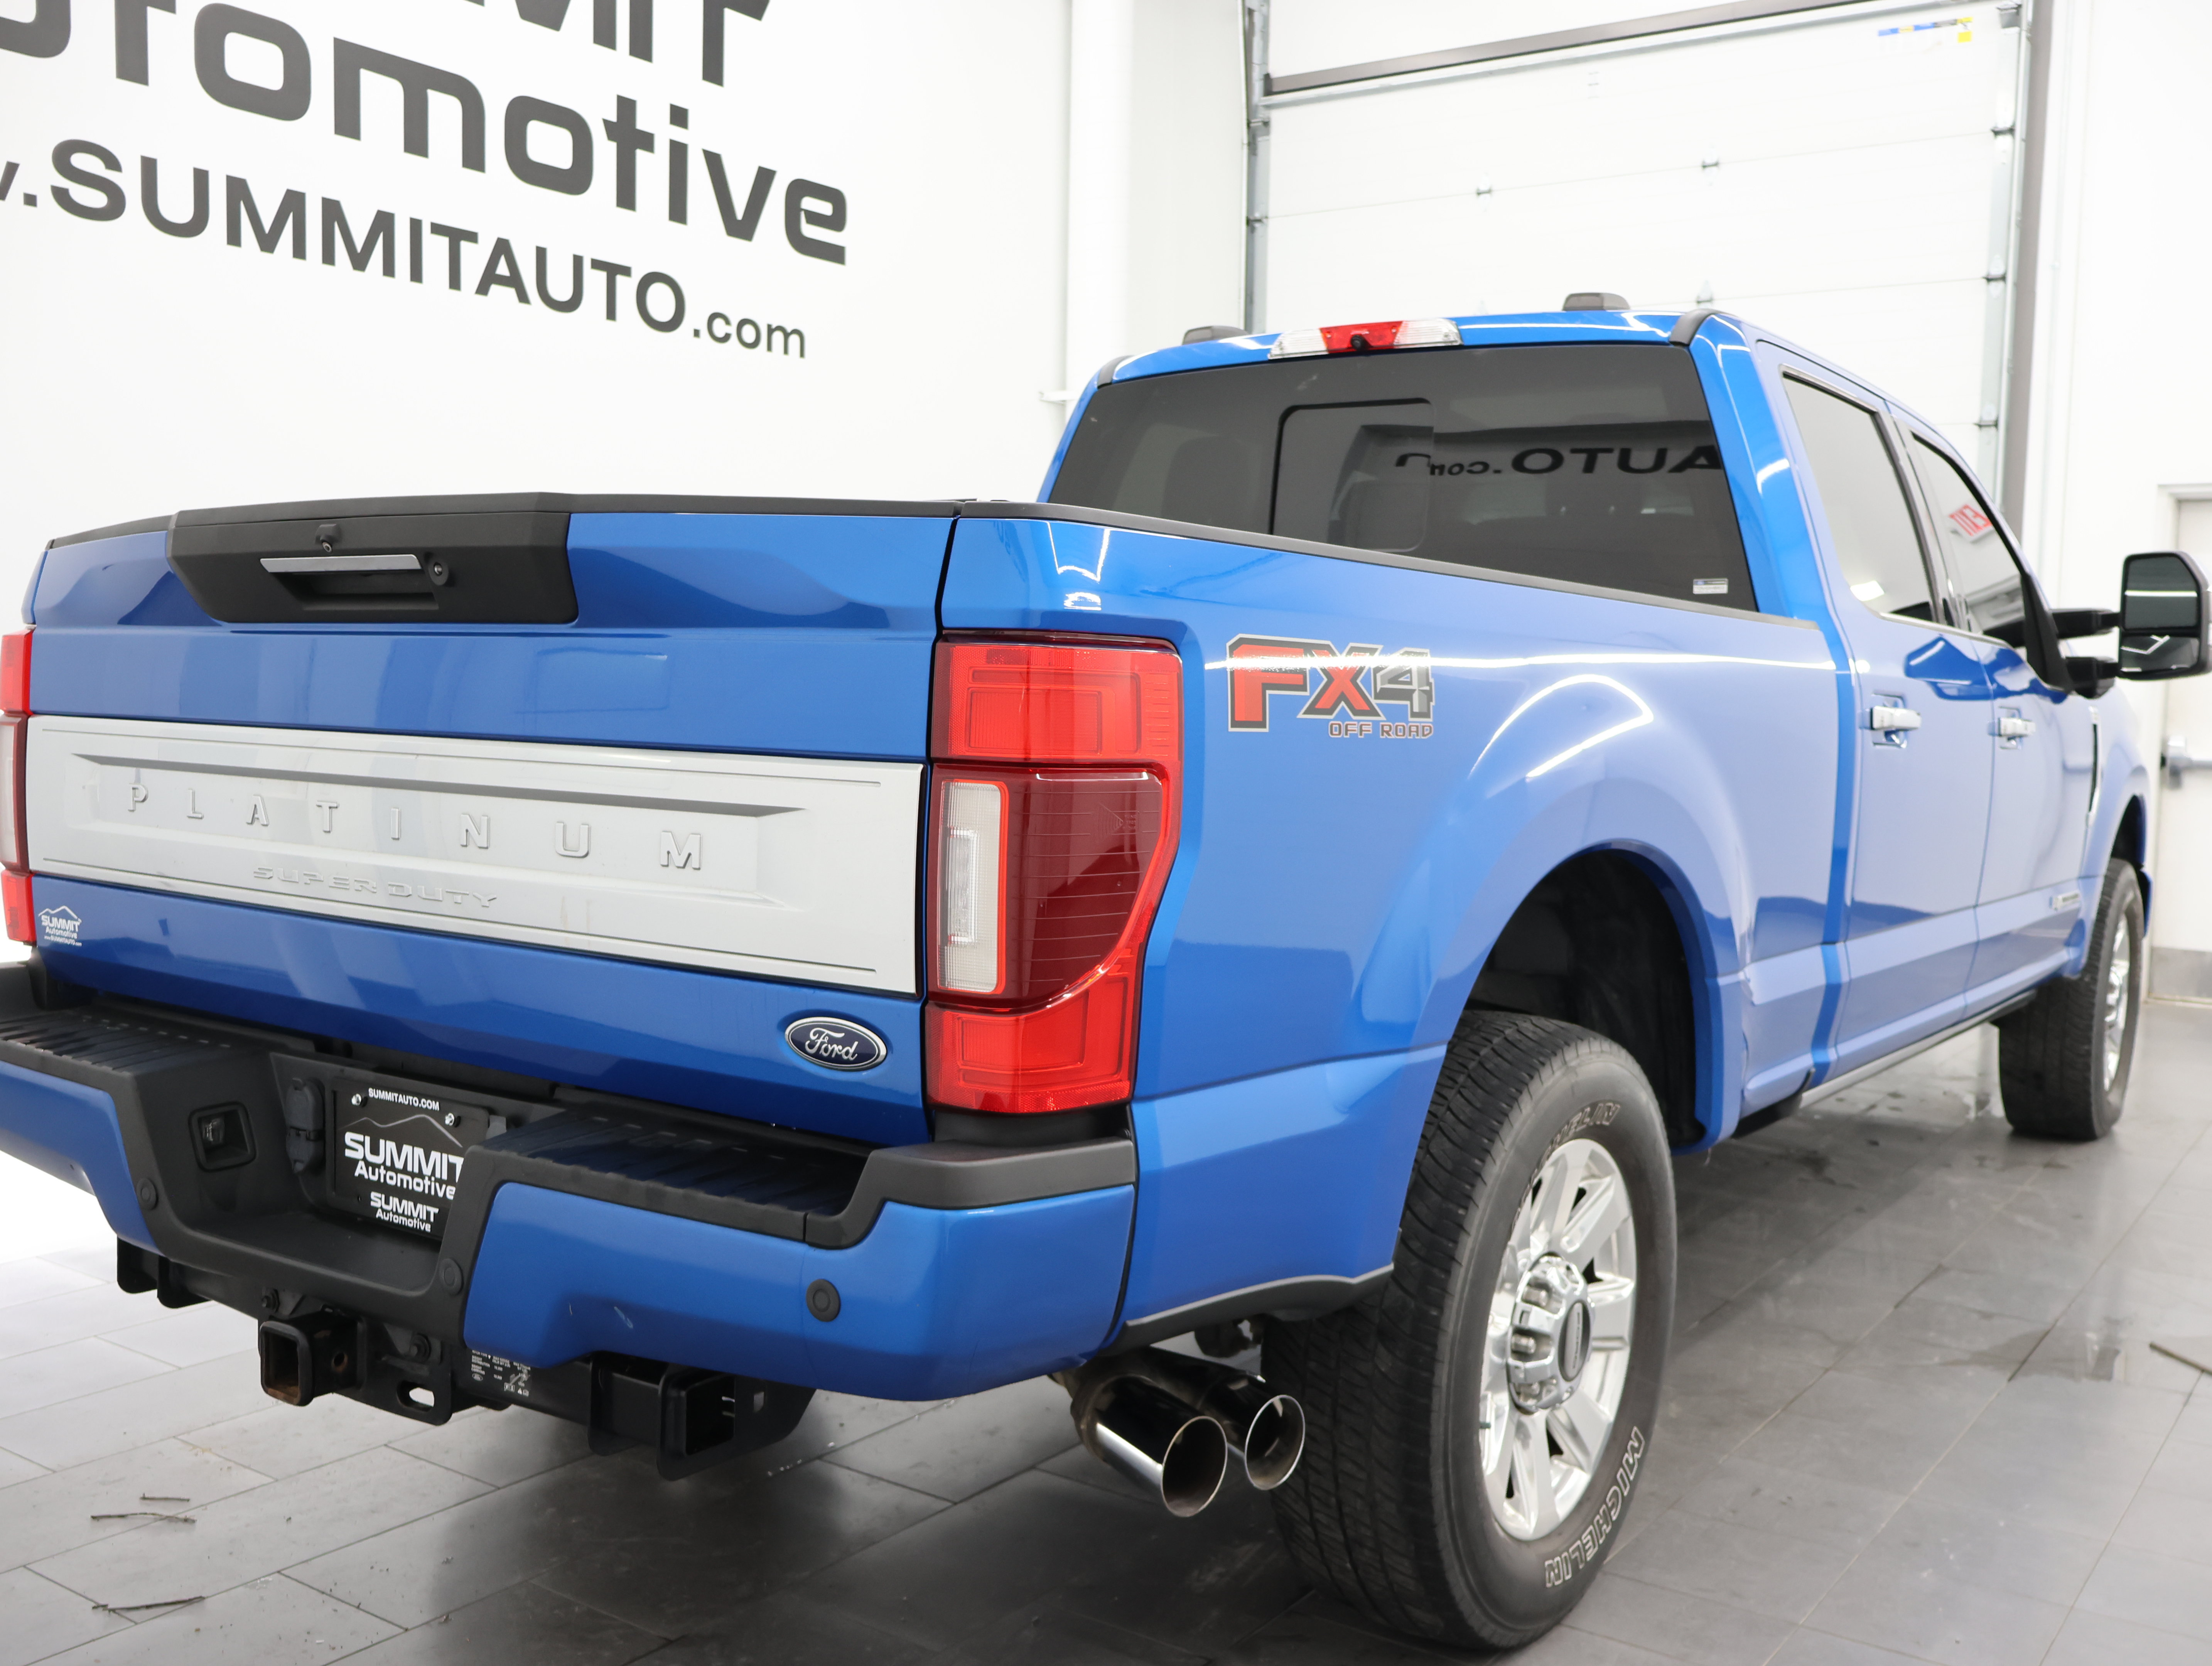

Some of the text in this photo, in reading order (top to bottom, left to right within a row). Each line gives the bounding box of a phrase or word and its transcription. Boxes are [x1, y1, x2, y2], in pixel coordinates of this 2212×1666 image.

[0, 138, 805, 359] .SUMMITAUTO.com
[1226, 633, 1435, 732] FX4
[1328, 721, 1434, 739] OFF ROAD
[127, 782, 702, 870] PLATINUM
[253, 867, 497, 907] SUPER DUTY
[41, 914, 80, 932] SUMMIT
[46, 926, 78, 939] Automotive
[805, 1027, 858, 1061] Ford
[368, 1088, 440, 1111] SUMMITAUTO.COM
[344, 1131, 464, 1183] SUMMIT
[354, 1160, 456, 1200] Automotive
[370, 1191, 439, 1223] SUMMIT
[376, 1208, 431, 1233] Automotive
[1544, 1426, 1645, 1588] MICHELIN
